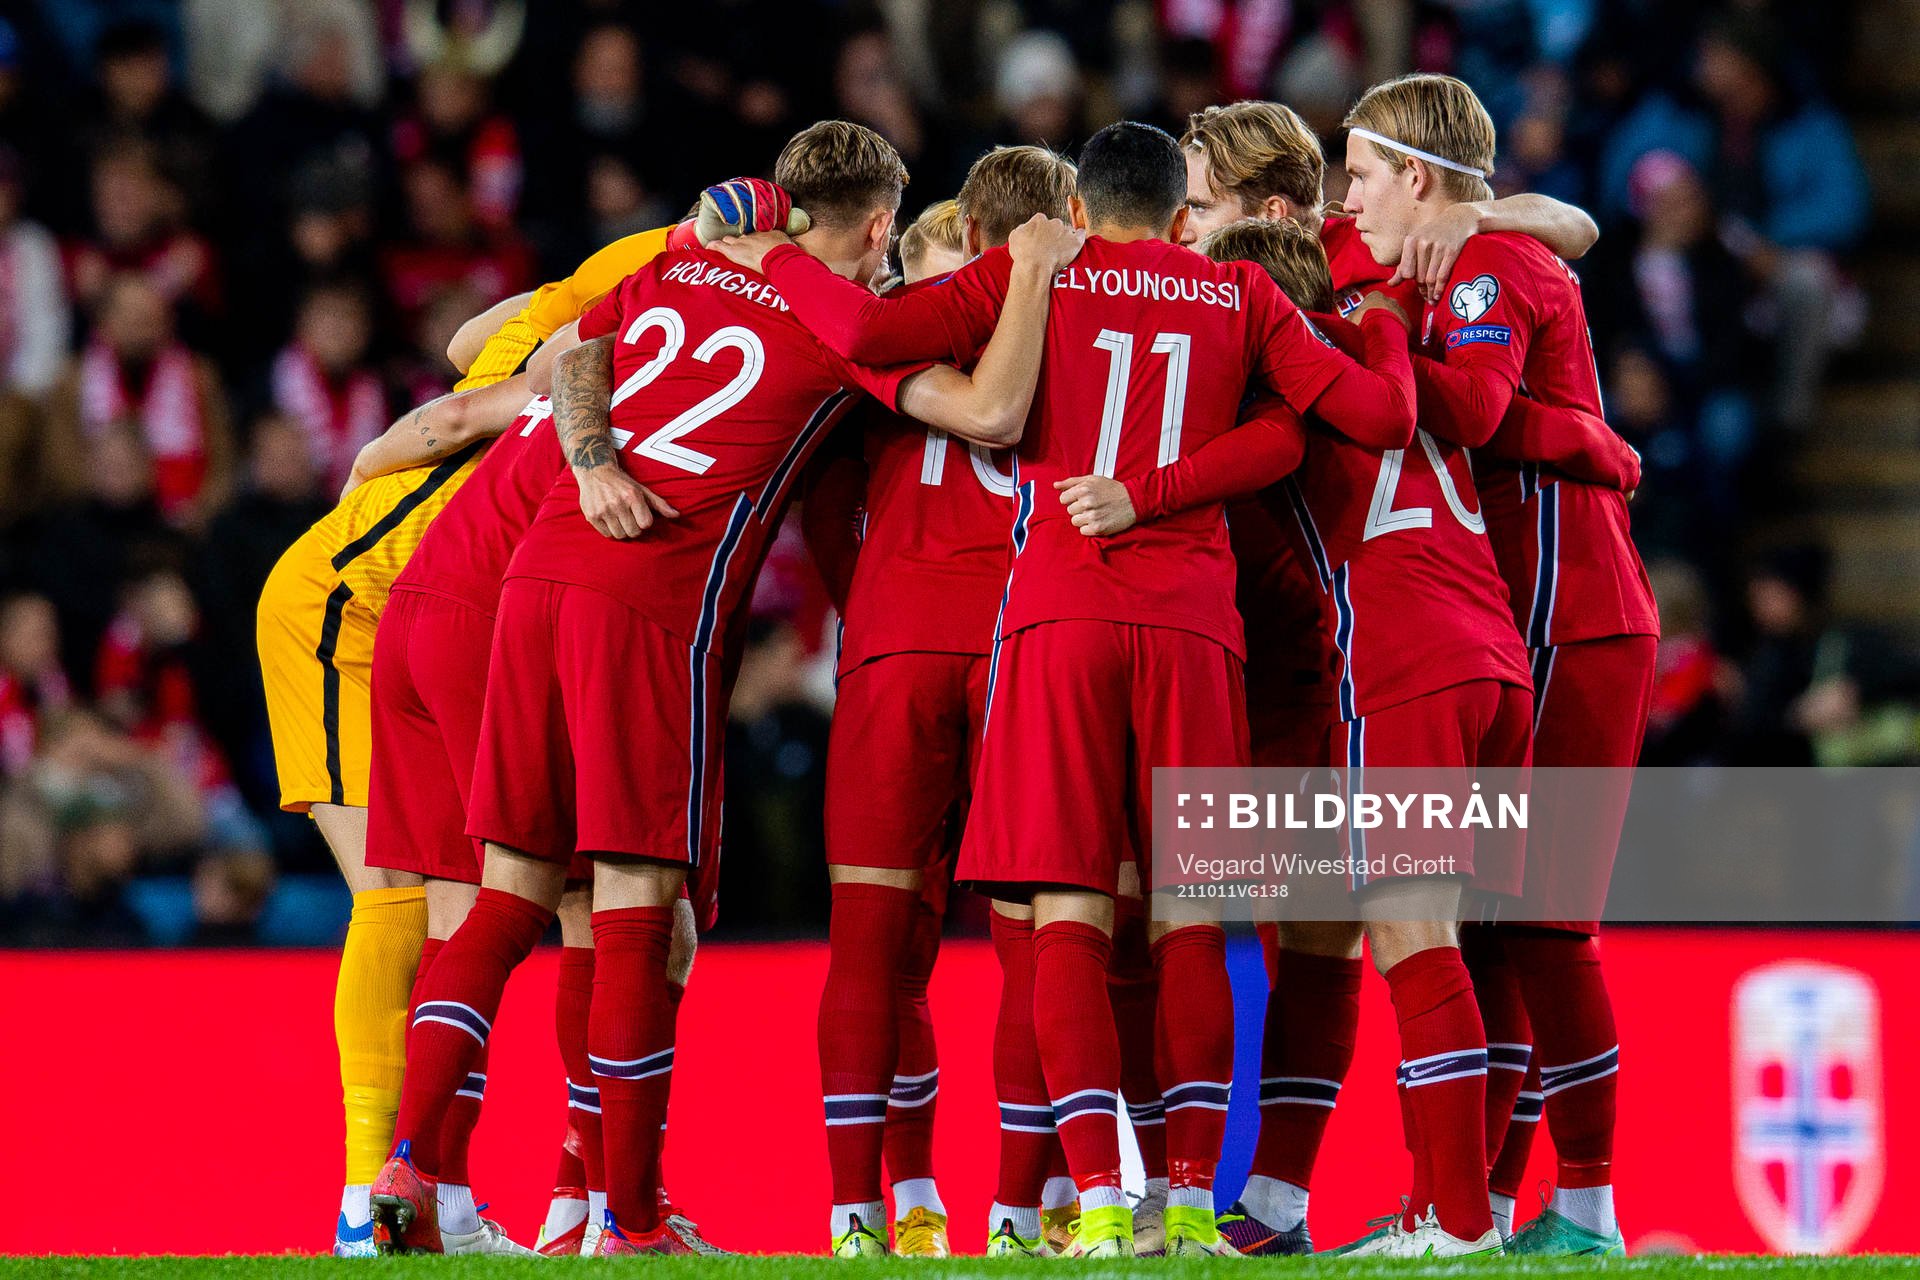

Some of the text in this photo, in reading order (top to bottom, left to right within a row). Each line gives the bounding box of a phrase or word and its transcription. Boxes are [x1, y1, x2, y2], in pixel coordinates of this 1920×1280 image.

[661, 261, 790, 312] HOLMGREN
[1053, 267, 1241, 312] ELYOUNOUSSI
[1462, 329, 1510, 341] RESPECT
[609, 306, 766, 476] 22
[1092, 328, 1192, 479] 11
